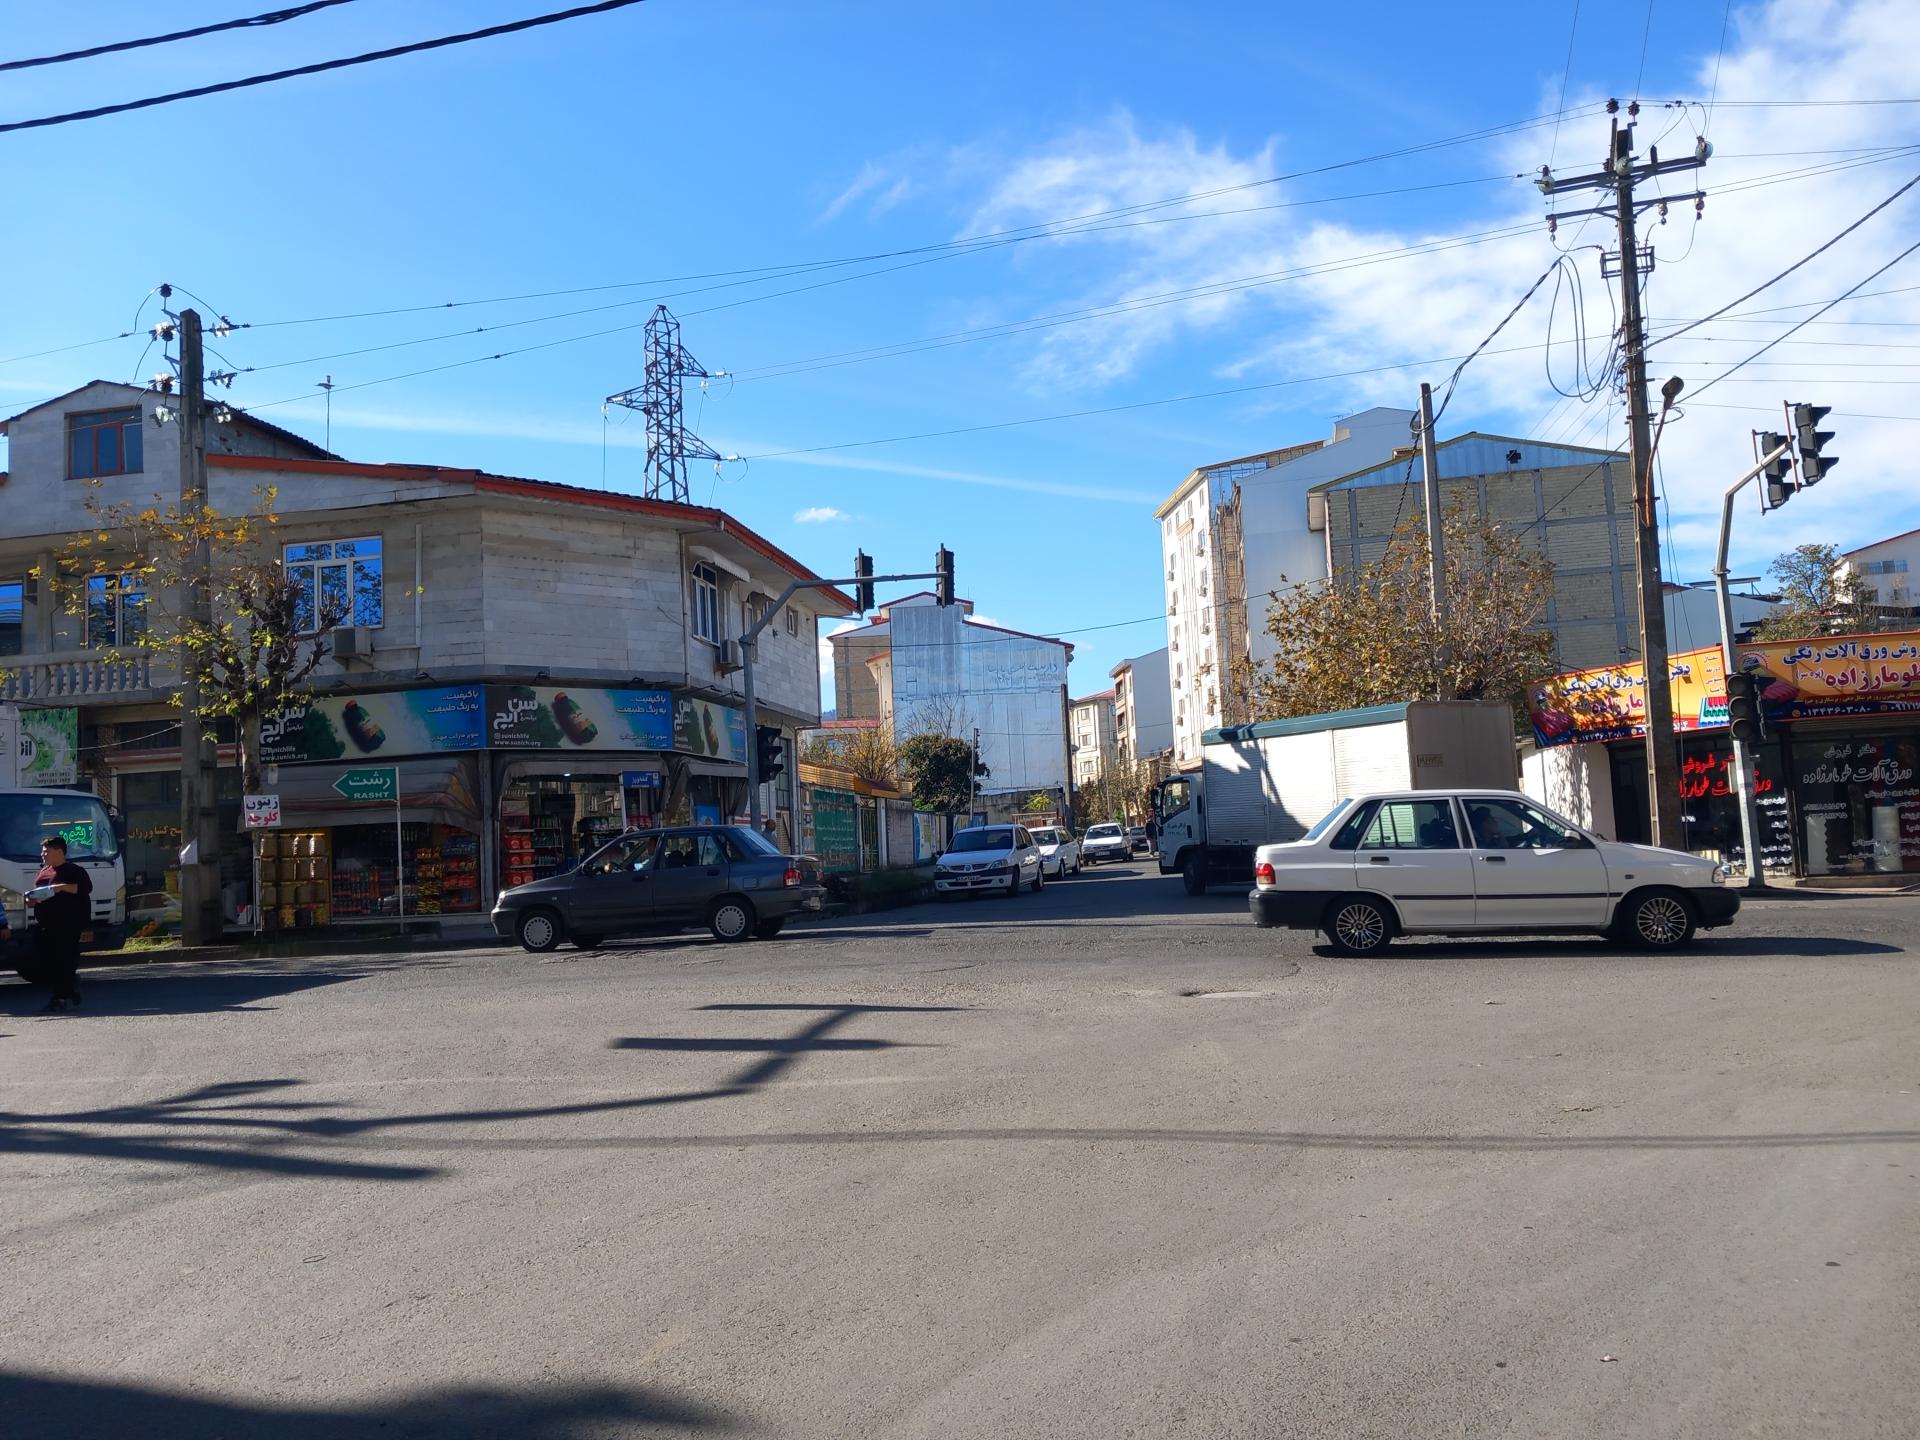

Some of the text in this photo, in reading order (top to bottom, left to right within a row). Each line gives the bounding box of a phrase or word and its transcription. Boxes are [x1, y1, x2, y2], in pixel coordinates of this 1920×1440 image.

[1783, 641, 1920, 665] وش ورق آلات رنگی
[507, 698, 539, 713] سن
[1592, 693, 1644, 717] مارزاده
[493, 711, 519, 730] ایچ
[348, 771, 391, 790] رشت
[246, 796, 279, 811] زیتون
[353, 791, 390, 799] RASHT
[247, 812, 279, 826] کلوچه
[59, 825, 93, 846] زیتون
